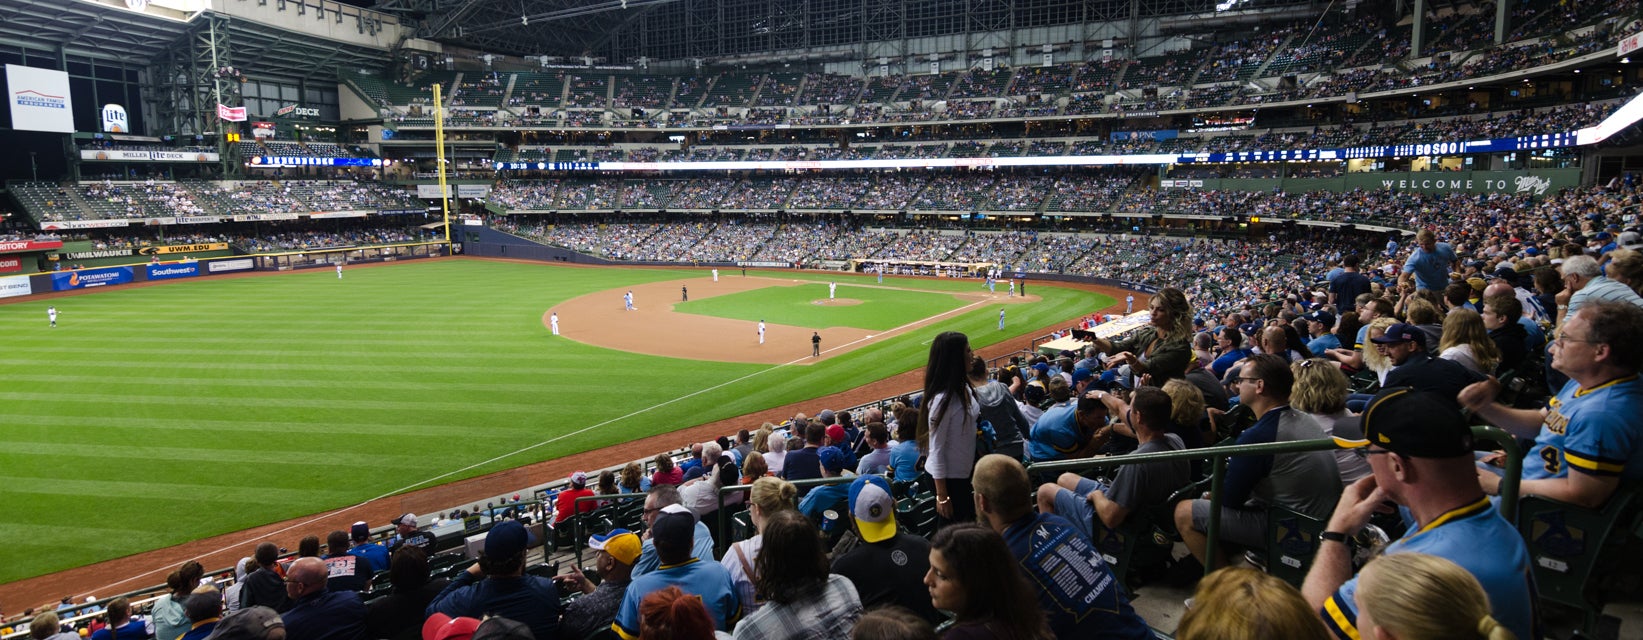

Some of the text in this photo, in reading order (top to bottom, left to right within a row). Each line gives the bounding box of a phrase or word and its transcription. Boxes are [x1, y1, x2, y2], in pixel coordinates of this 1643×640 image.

[106, 109, 124, 122] Lite
[296, 108, 320, 116] DECK
[1139, 131, 1157, 139] PNC
[149, 151, 166, 161] Lite
[1382, 179, 1473, 190] WELCOME
[1486, 180, 1506, 190] TO
[152, 267, 190, 276] Southwest
[79, 272, 119, 281] POTAWATOMI
[1540, 446, 1560, 474] 4
